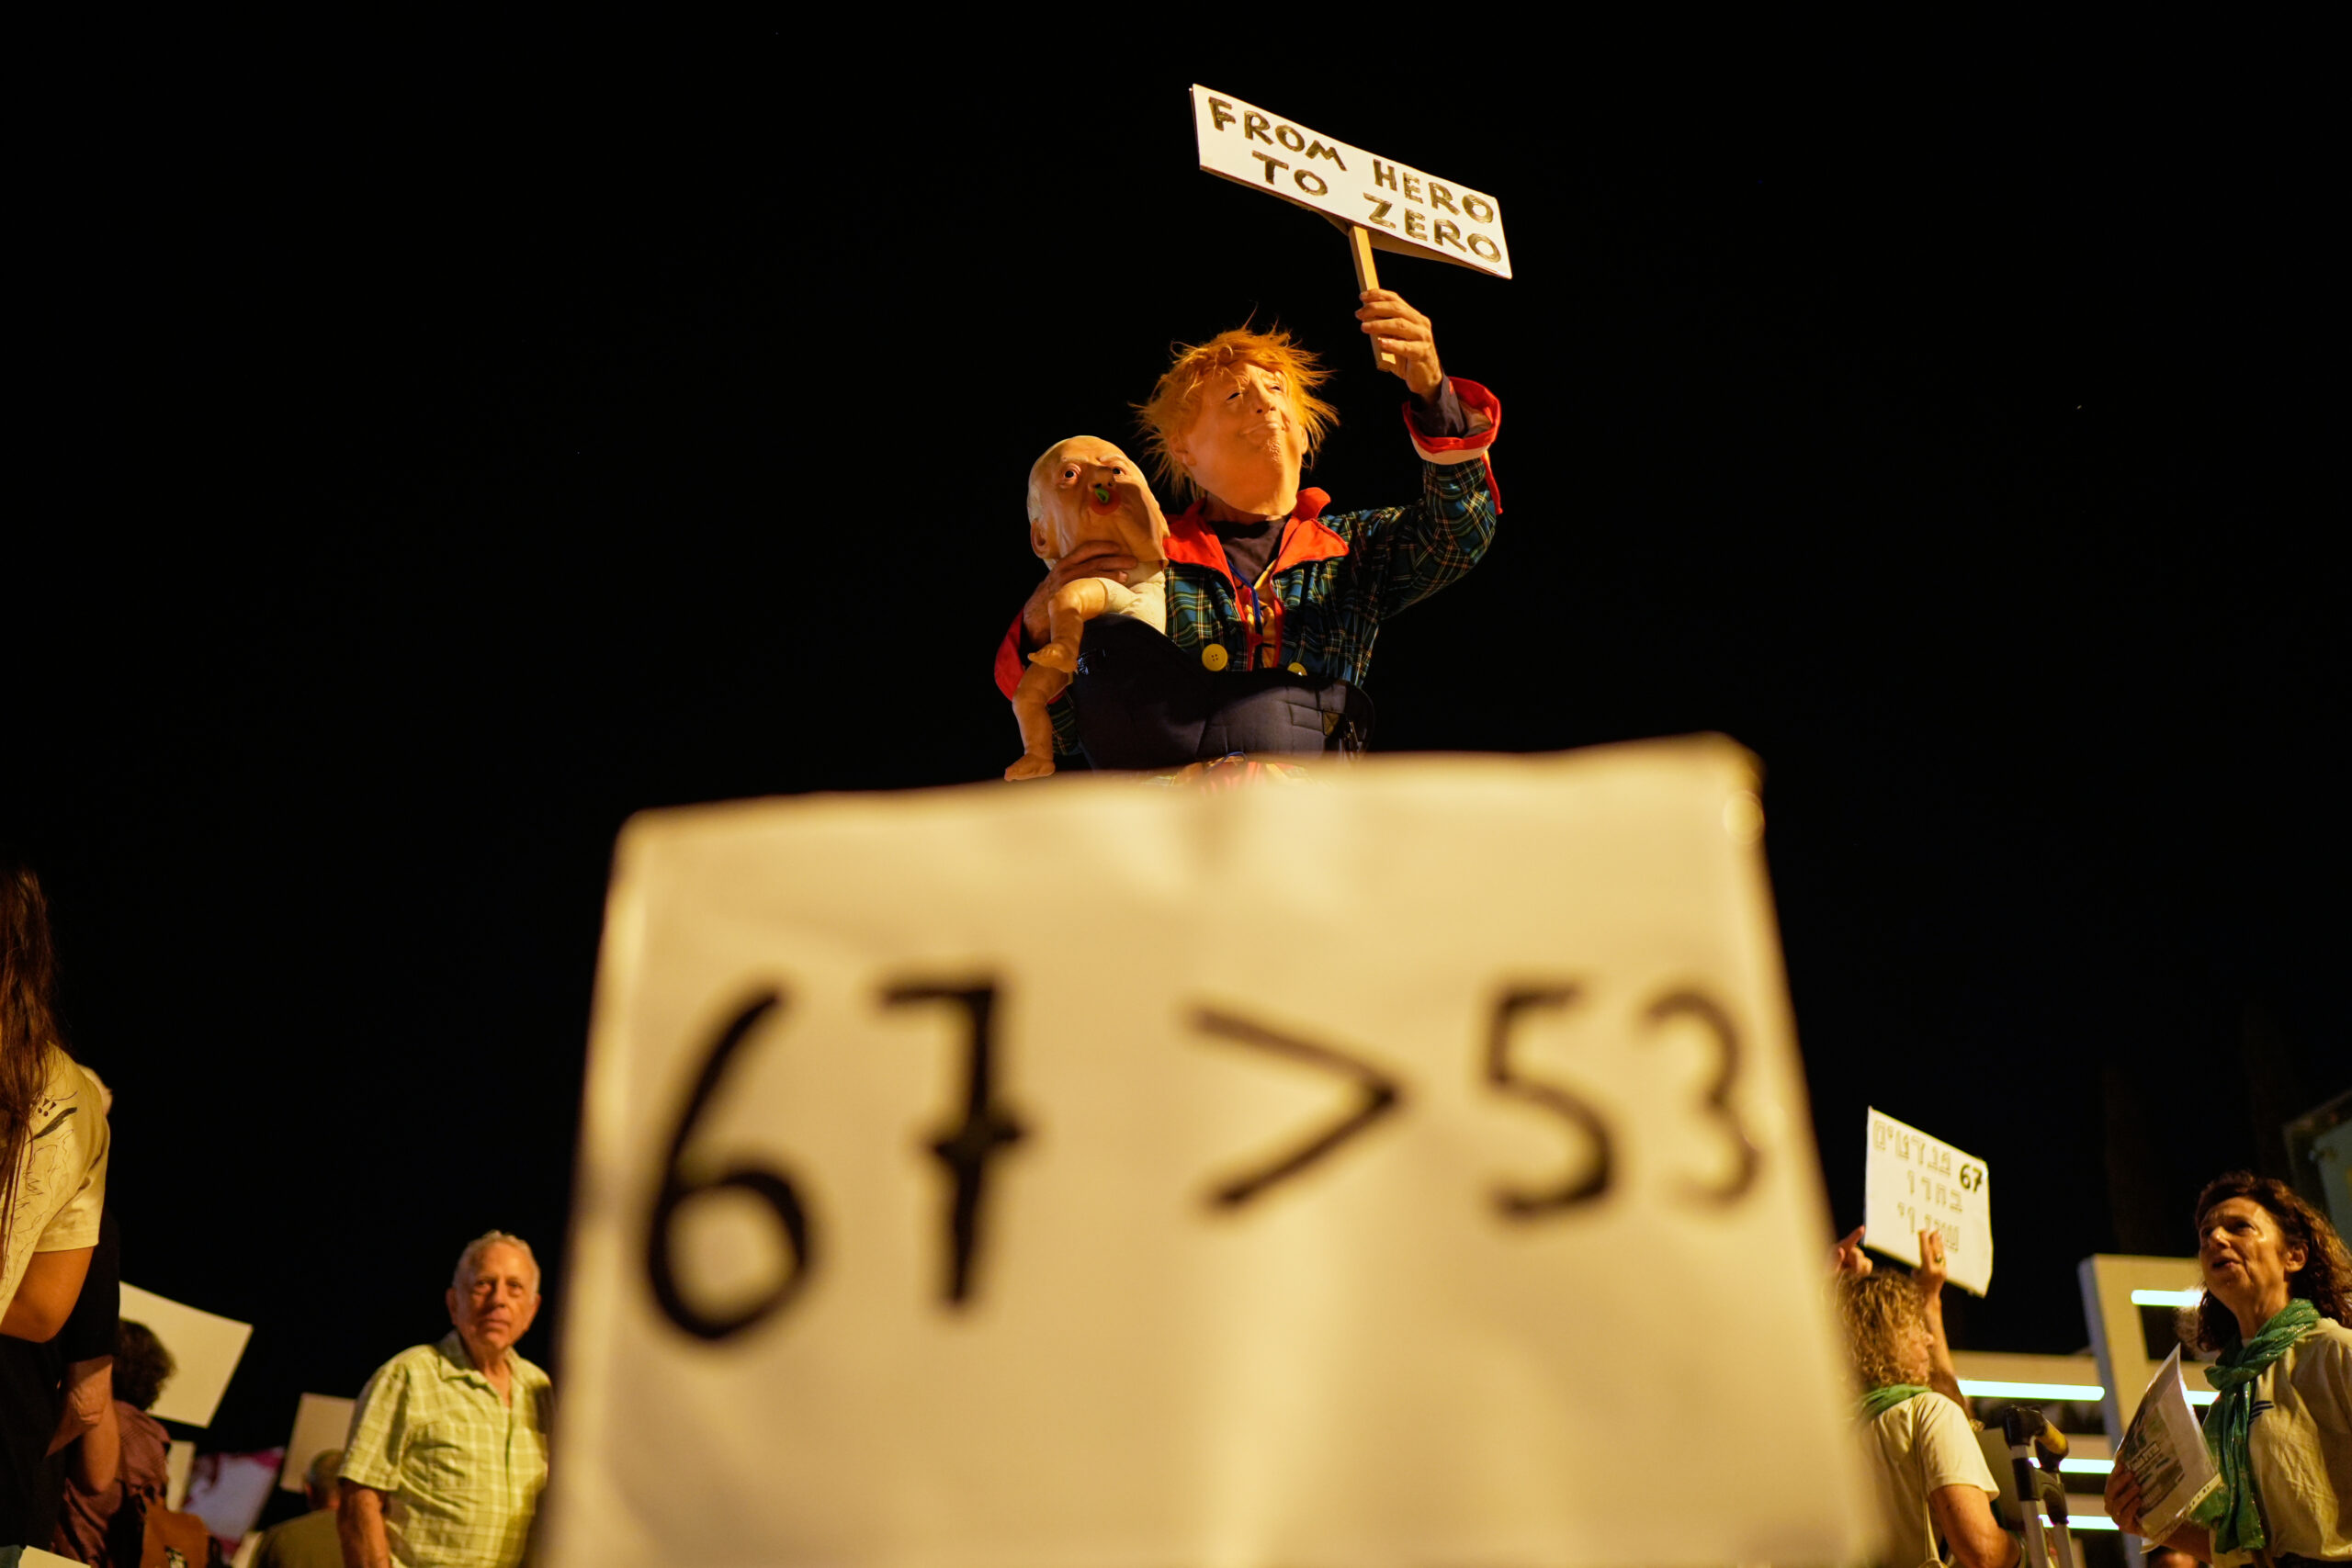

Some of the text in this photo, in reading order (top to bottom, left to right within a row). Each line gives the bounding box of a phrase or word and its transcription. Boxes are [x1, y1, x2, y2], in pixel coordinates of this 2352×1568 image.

[1208, 96, 1495, 223] FROM HERO
[1251, 150, 1502, 263] TO ZERO
[643, 979, 1031, 1345] 67
[1481, 983, 1762, 1222] 53
[1960, 1163, 1983, 1192] 67
